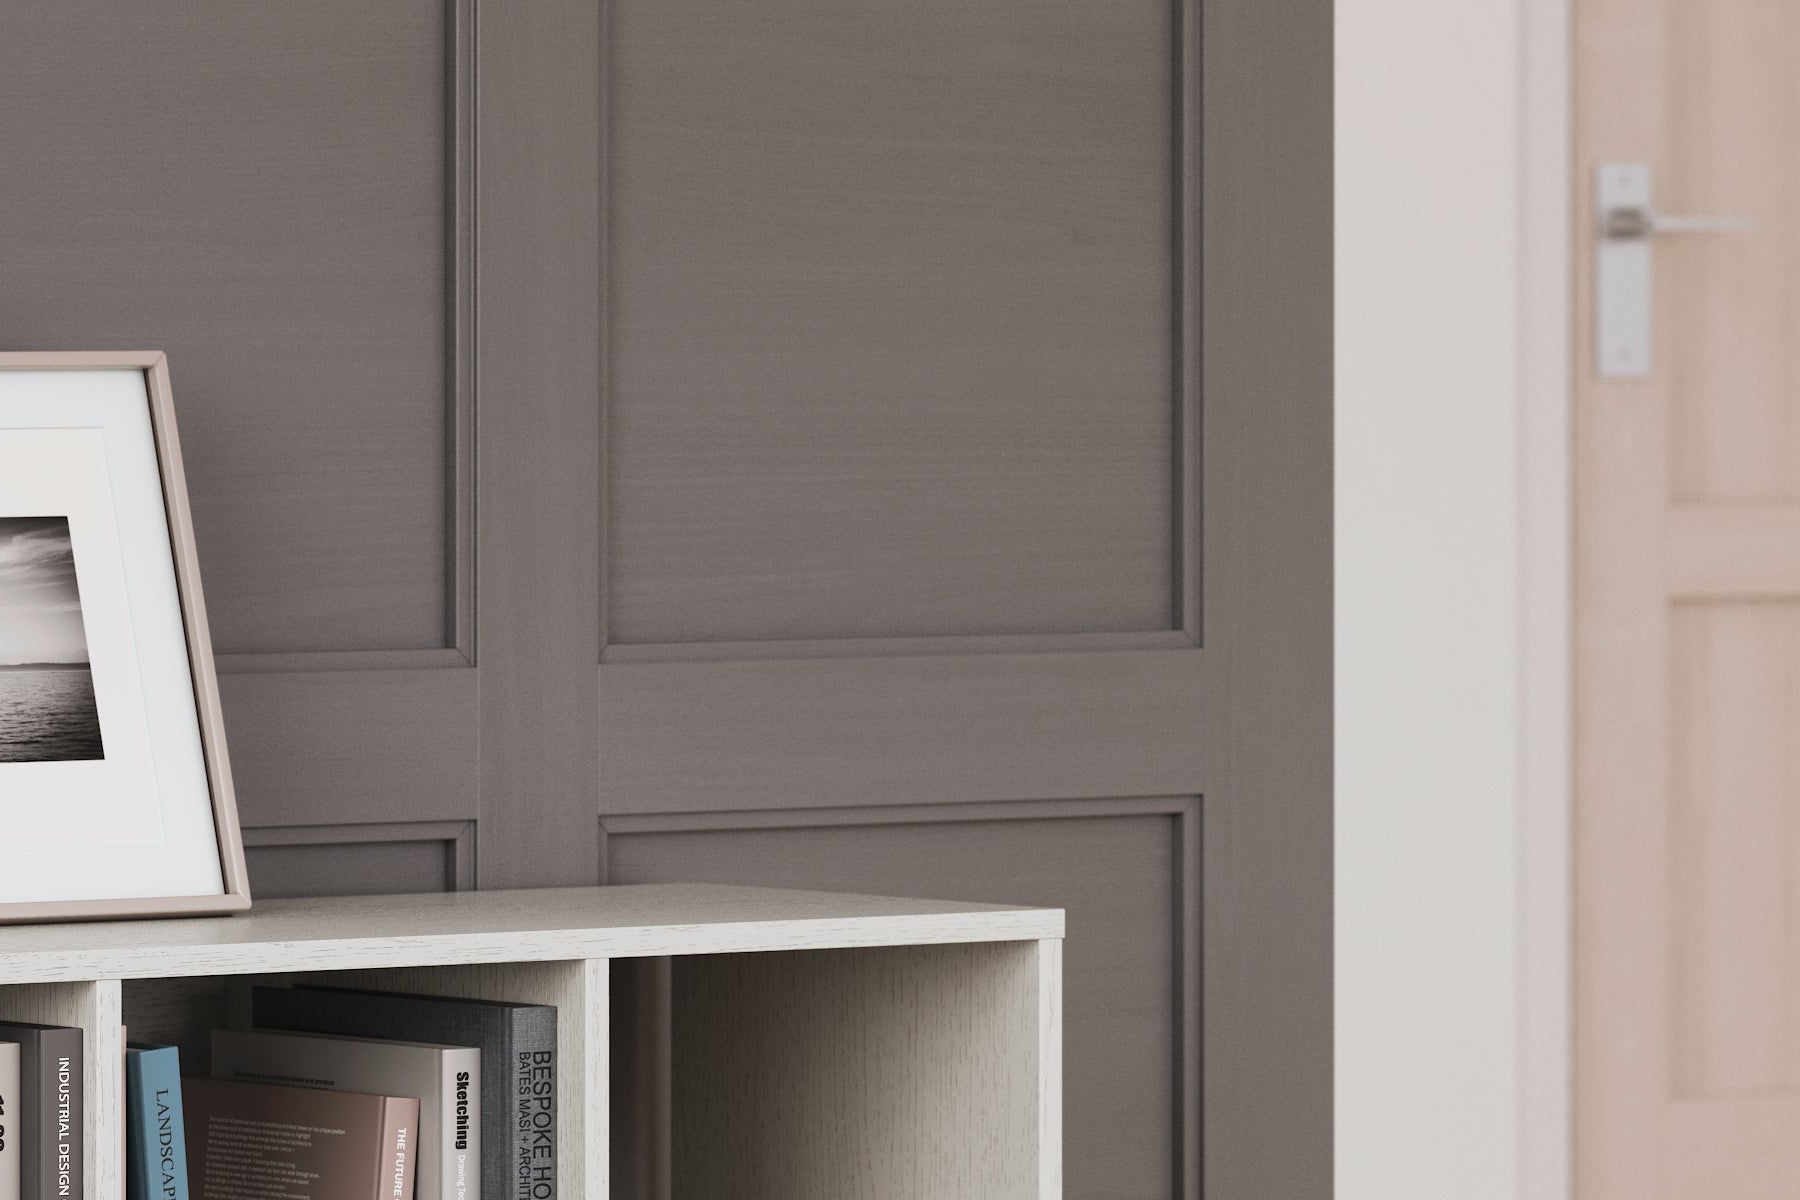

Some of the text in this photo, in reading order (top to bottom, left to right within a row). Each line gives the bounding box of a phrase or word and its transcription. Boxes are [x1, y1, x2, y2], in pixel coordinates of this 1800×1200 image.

[519, 1052, 531, 1095] BATES
[59, 1058, 70, 1140] INDUSTRIAL
[455, 1072, 469, 1149] Sketching
[519, 1099, 530, 1132] MASI
[533, 1051, 551, 1158] BESPOKE
[397, 1128, 406, 1149] THE
[59, 1144, 70, 1196] DESIGN
[394, 1153, 404, 1196] FUTURE
[456, 1155, 465, 1186] Drawing
